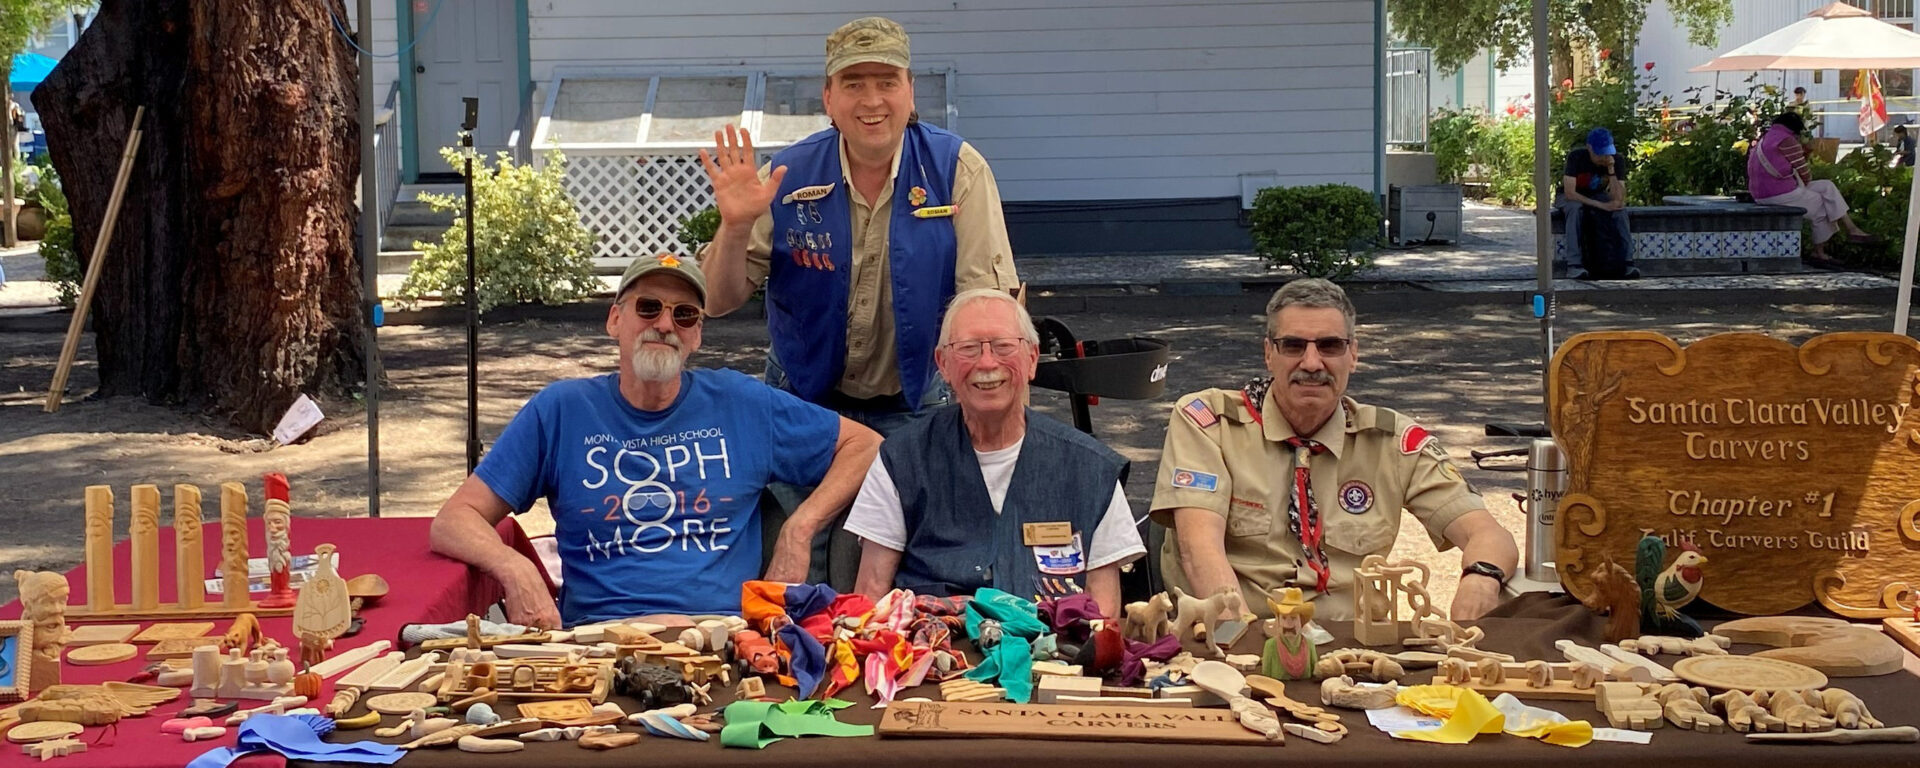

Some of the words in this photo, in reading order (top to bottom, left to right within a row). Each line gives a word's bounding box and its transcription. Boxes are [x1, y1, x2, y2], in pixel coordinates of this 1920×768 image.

[797, 188, 827, 199] ROMAN
[1625, 396, 1719, 425] Santa
[1723, 397, 1807, 425] Clara
[1807, 397, 1911, 434] Valley
[621, 438, 648, 449] VISTA
[650, 433, 677, 447] HIGH
[679, 427, 724, 441] SCHOOL
[1680, 431, 1811, 461] Carvers
[582, 437, 732, 490] SOPH
[1666, 488, 1793, 526] Chapter
[1804, 489, 1839, 518] #1
[585, 516, 732, 563] MORE
[1705, 528, 1799, 550] Carvers
[1804, 529, 1872, 552] Guild
[958, 709, 1047, 717] SANTA
[1057, 711, 1151, 719] CLARA
[1046, 720, 1177, 729] CARVERS
